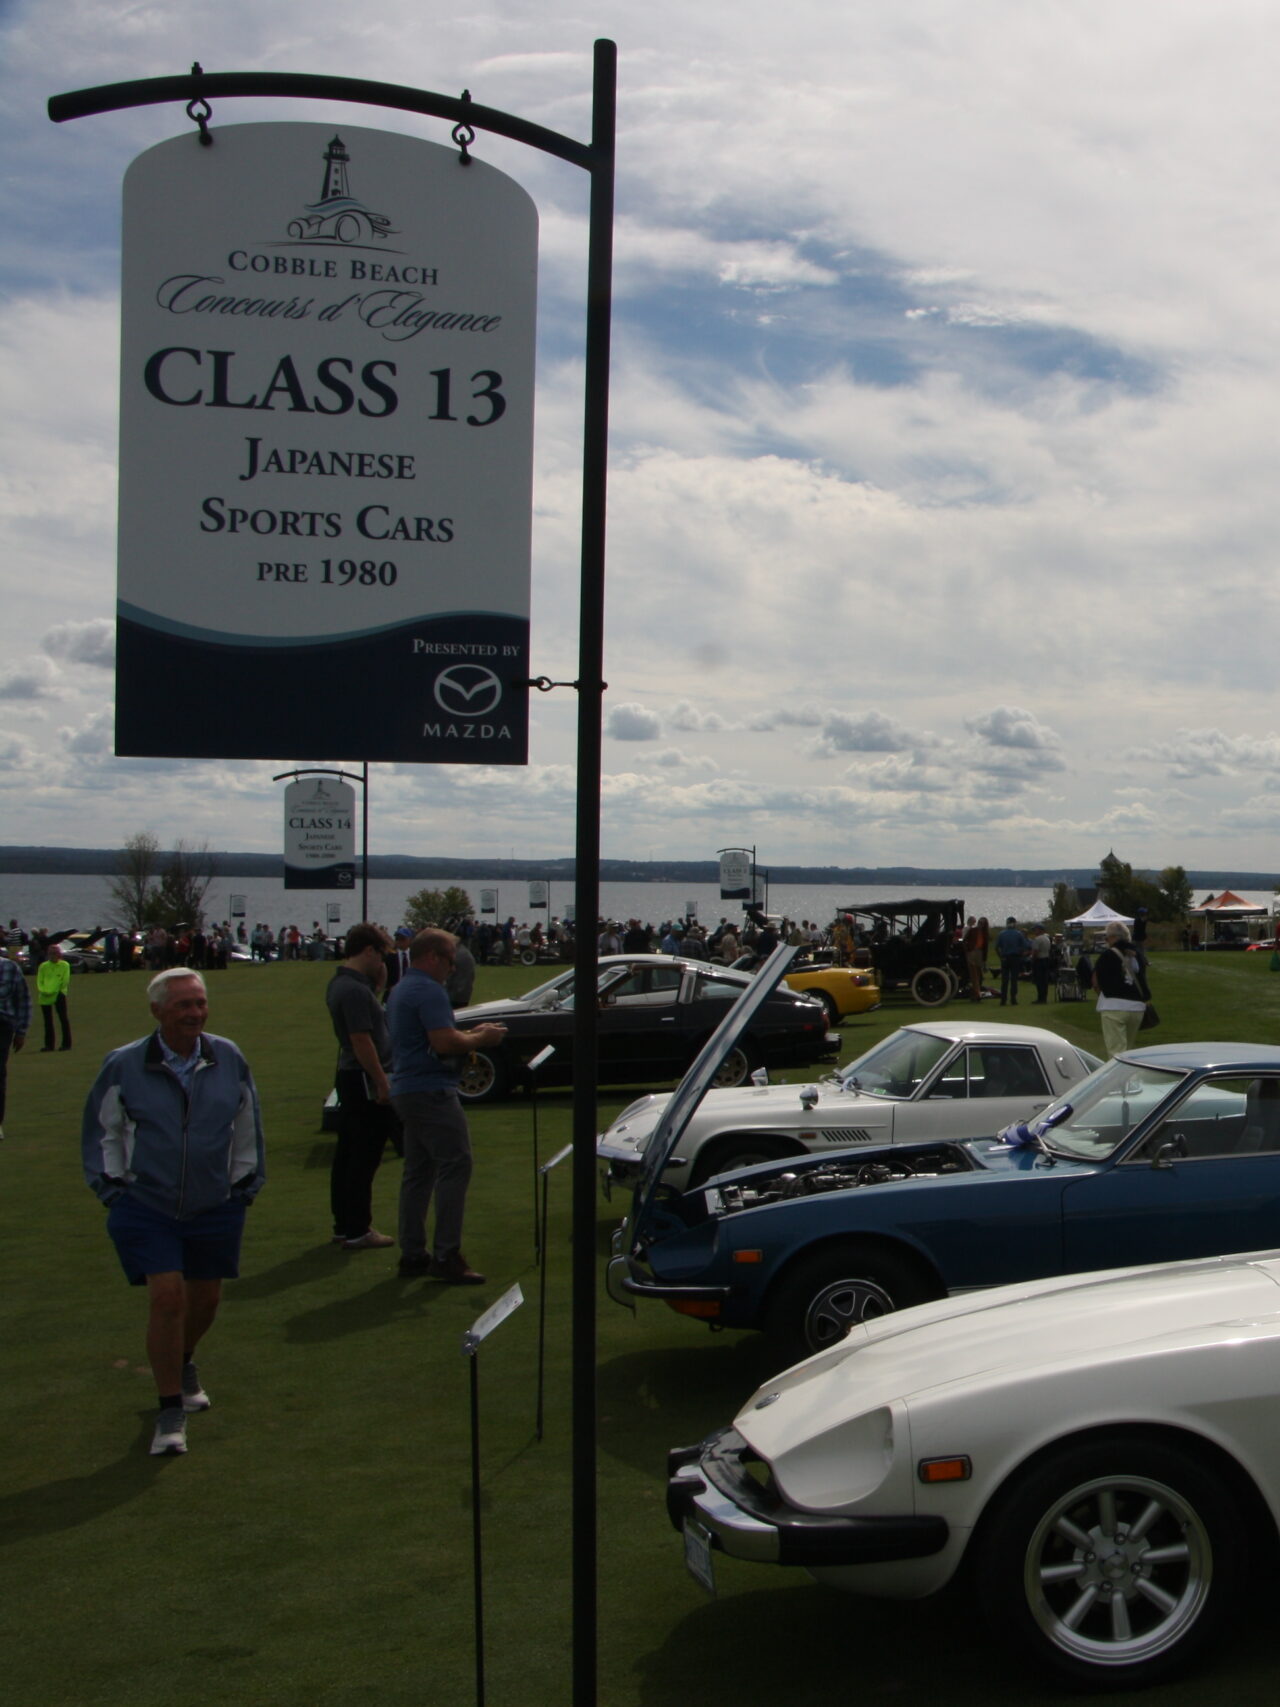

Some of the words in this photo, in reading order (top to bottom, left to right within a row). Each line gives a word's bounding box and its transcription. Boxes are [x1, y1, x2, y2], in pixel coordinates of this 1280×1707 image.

[228, 251, 337, 278] COBBLE
[351, 261, 439, 286] BEACH
[157, 275, 311, 320] Concours
[319, 290, 501, 341] d'Elegance
[143, 347, 399, 418] CLASS
[428, 367, 507, 427] 13
[239, 437, 416, 481] JAPANESE
[200, 497, 342, 538] SPORTS
[356, 505, 455, 543] CARS
[257, 561, 308, 583] PRE
[320, 559, 398, 587] 1980
[411, 638, 498, 657] PRESENTED
[502, 644, 521, 658] BY
[422, 722, 512, 740] MAZDA
[289, 818, 333, 829] CLASS
[338, 819, 351, 829] 14
